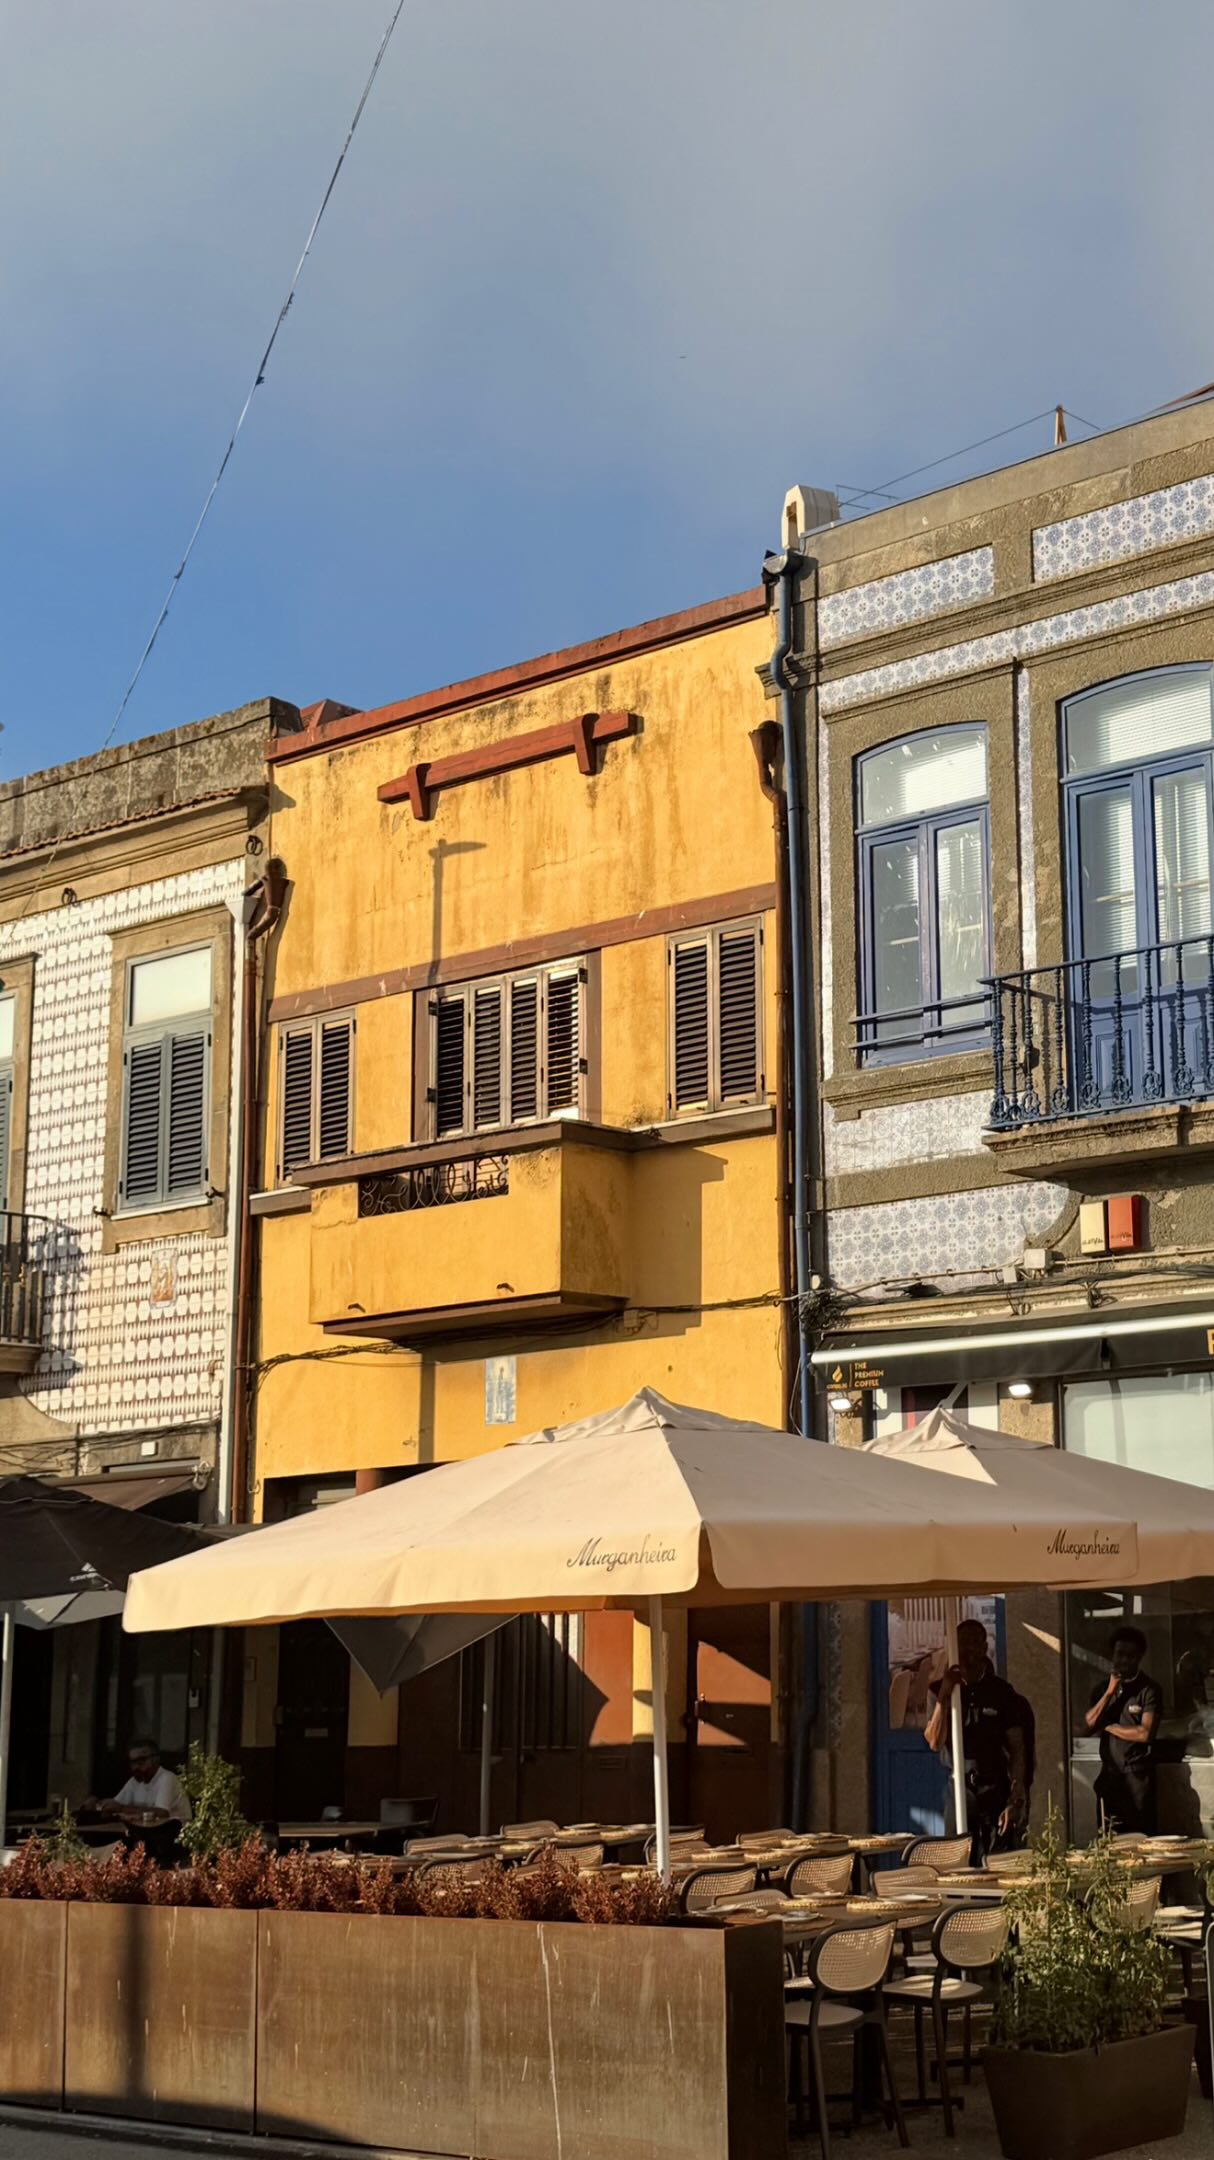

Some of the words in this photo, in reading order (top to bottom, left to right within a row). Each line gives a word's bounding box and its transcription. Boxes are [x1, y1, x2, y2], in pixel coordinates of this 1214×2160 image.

[854, 1361, 866, 1370] THE
[854, 1379, 879, 1388] COFFEE
[566, 1533, 676, 1572] Murganheira
[1046, 1528, 1120, 1561] Murganheira
